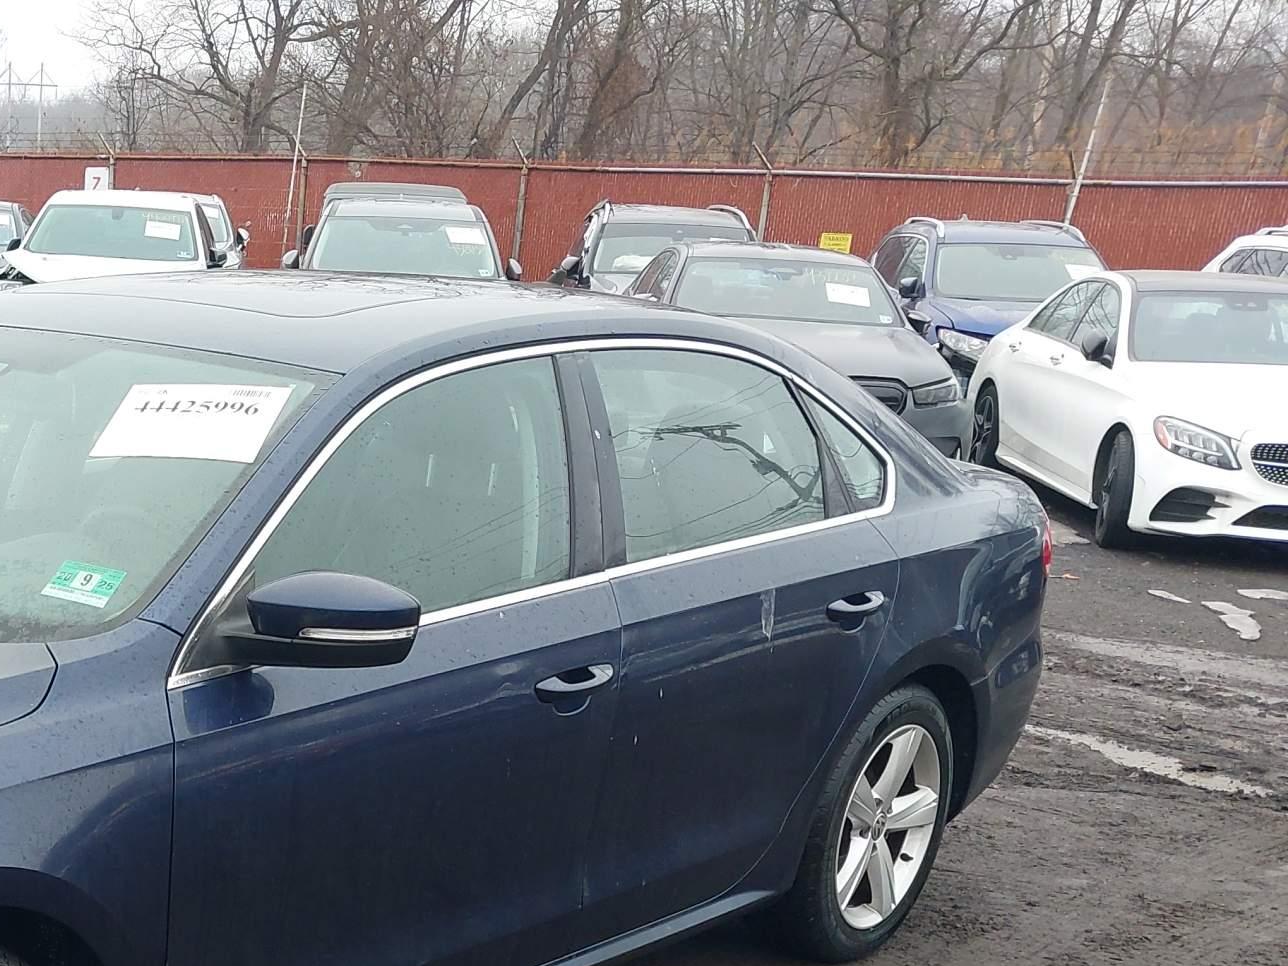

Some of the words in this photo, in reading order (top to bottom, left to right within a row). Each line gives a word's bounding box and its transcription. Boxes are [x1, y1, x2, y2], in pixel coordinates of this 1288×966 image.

[92, 176, 101, 190] 7
[134, 400, 261, 416] 44425996
[80, 573, 94, 587] 9
